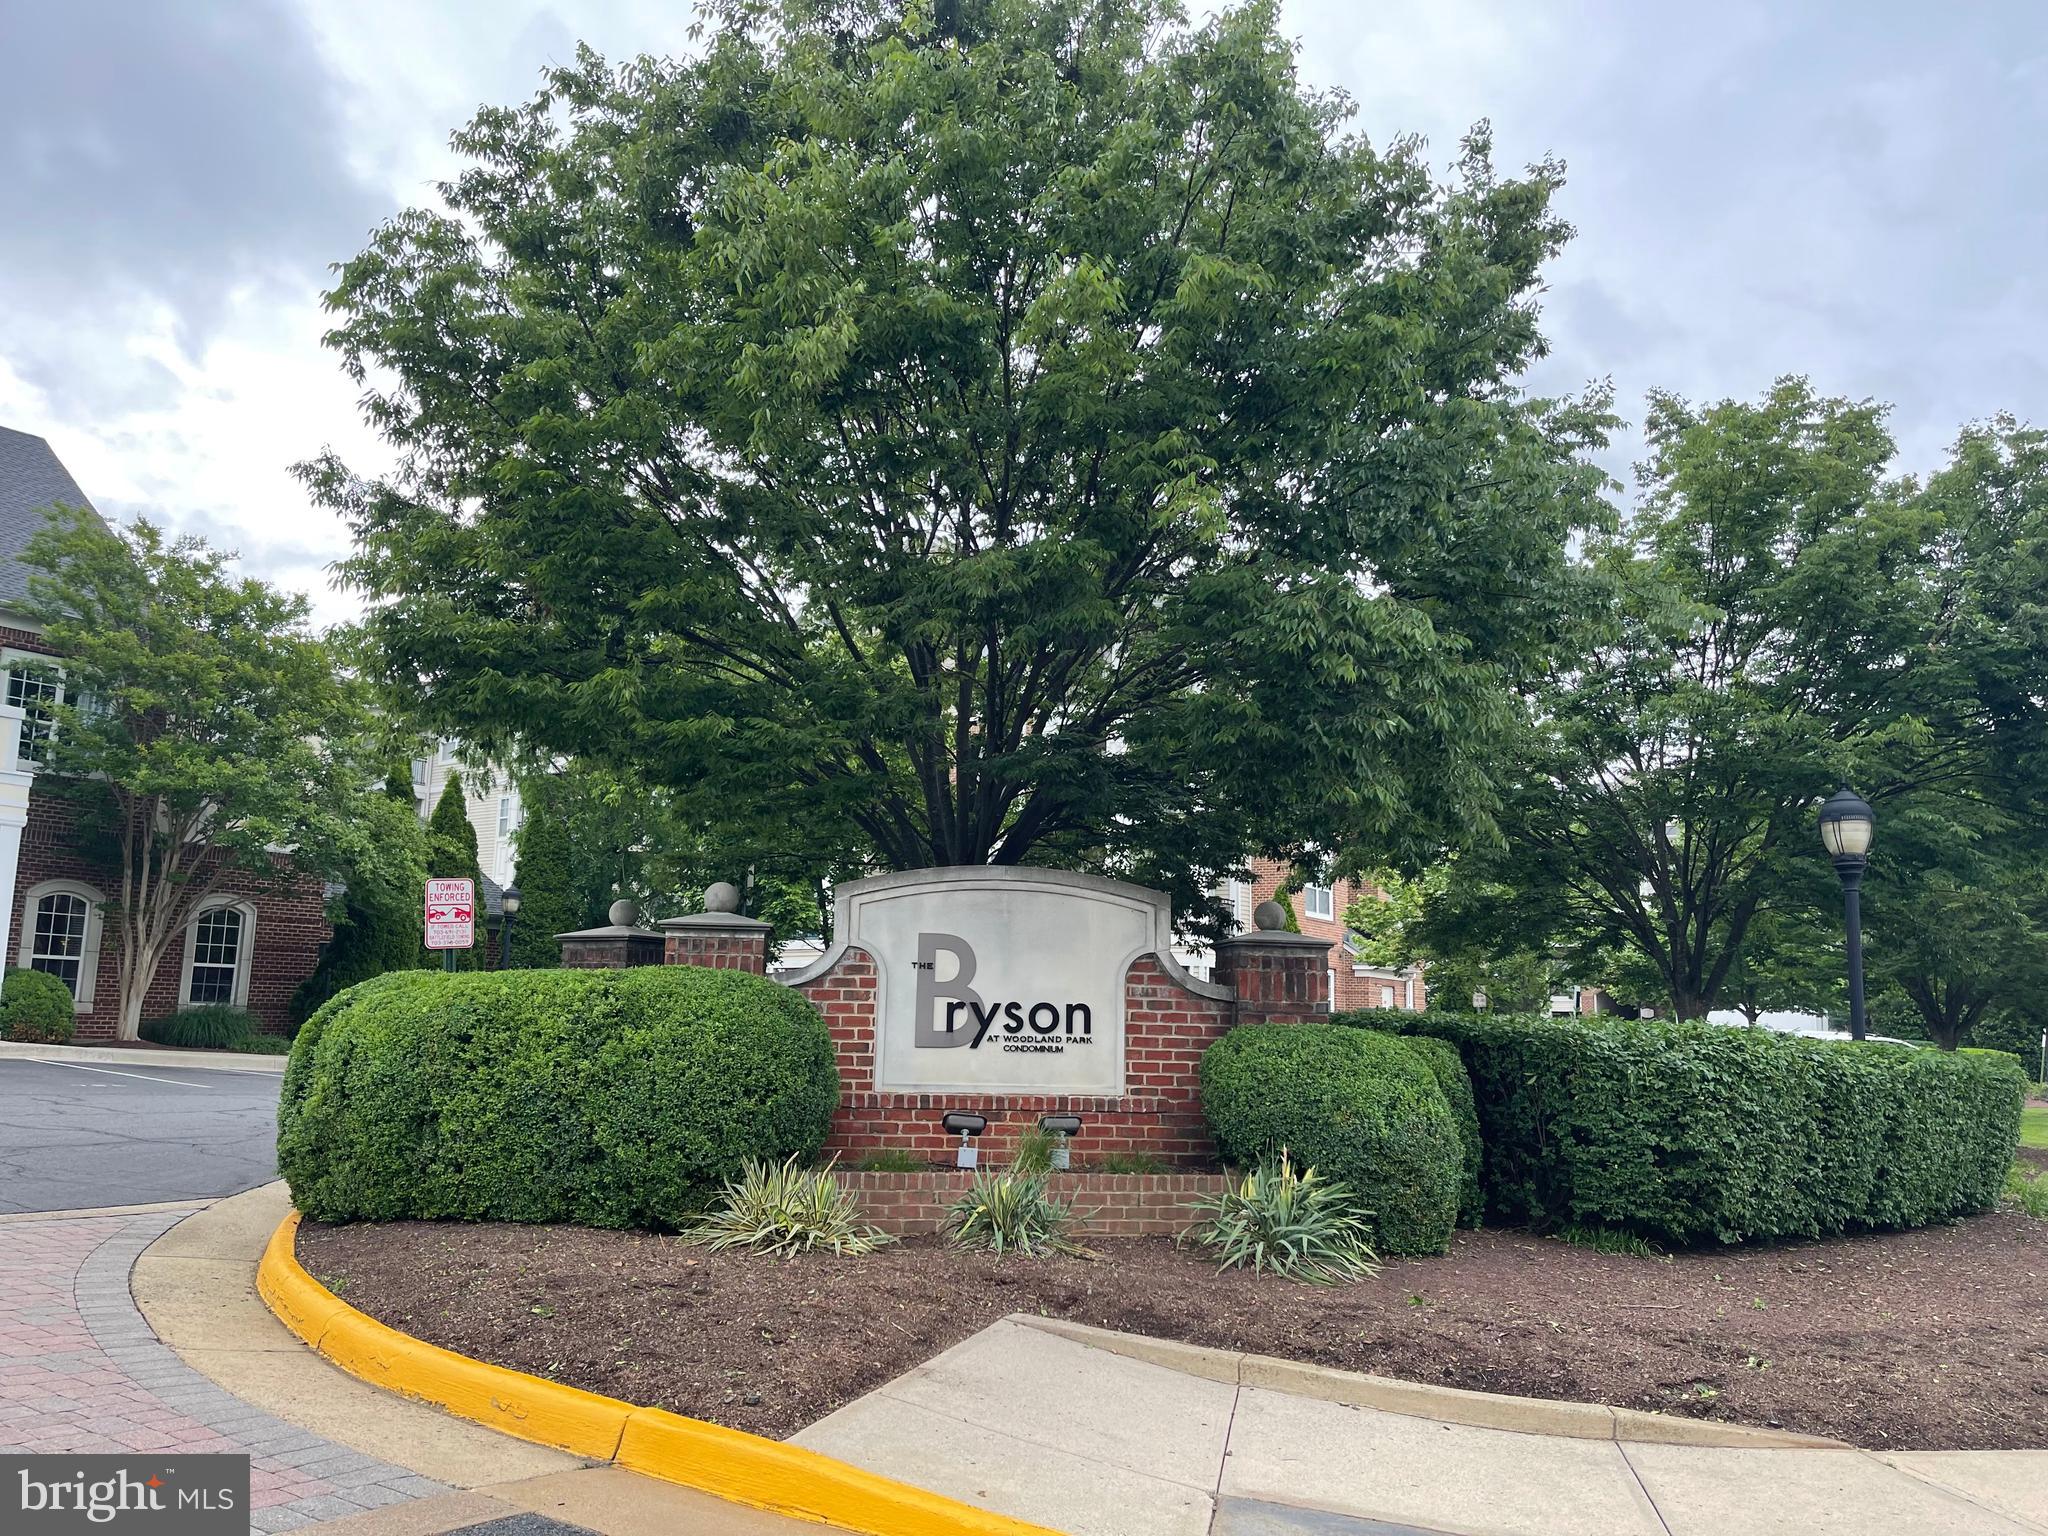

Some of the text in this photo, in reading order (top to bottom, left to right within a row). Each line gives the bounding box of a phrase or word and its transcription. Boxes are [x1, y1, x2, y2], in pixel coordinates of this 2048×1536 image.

[436, 883, 465, 891] TOWING
[430, 892, 470, 901] ENFORCED
[911, 962, 934, 970] THE
[915, 933, 1092, 1049] Bryson
[1003, 1035, 1062, 1043] WOODLAND
[1066, 1036, 1093, 1044] PARK
[1003, 1044, 1064, 1053] CONDOMINIUM
